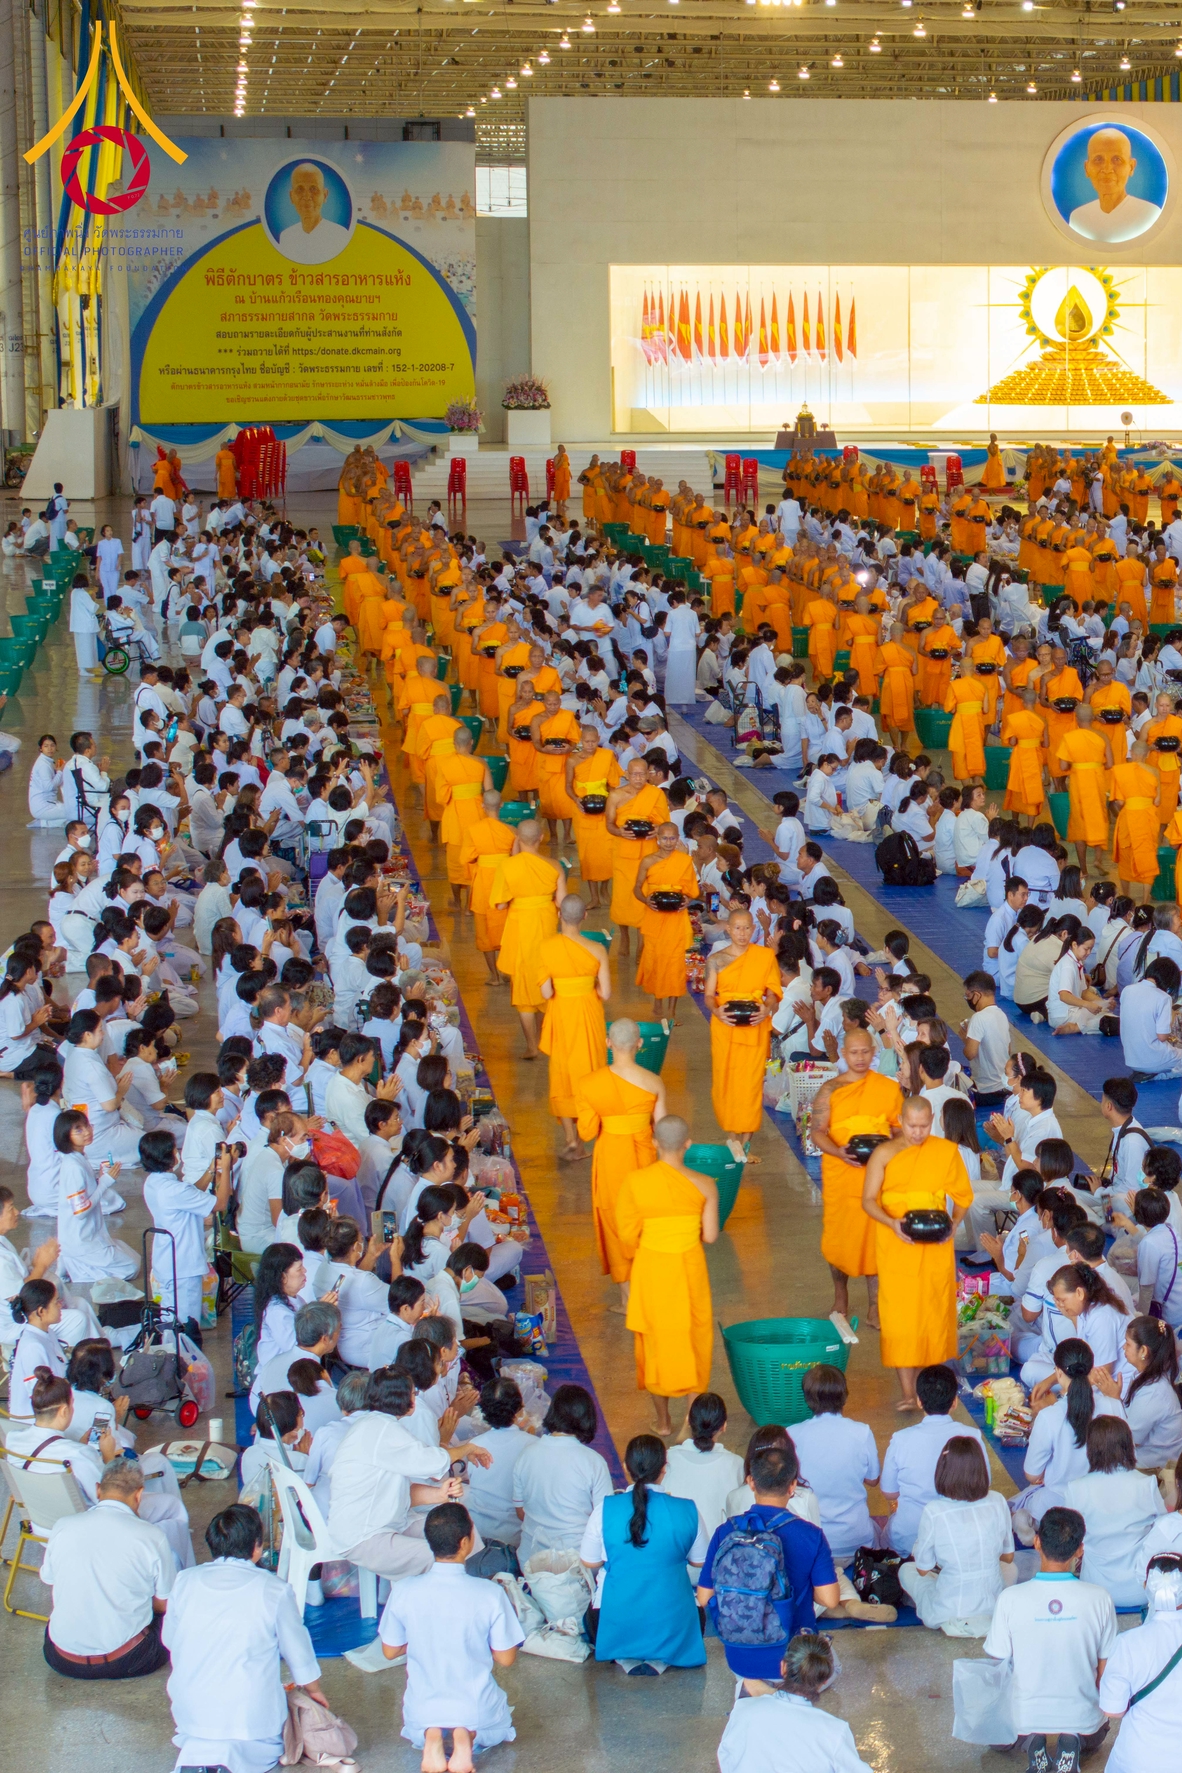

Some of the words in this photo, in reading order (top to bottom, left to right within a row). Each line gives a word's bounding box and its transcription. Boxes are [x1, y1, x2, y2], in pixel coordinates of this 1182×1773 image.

[204, 267, 283, 286] พิธีตักบาตร
[289, 267, 411, 286] ข้าวสารอาหารแห้ง
[234, 295, 246, 305] ณ
[249, 290, 381, 308] บ้านแก้วเรือนทองคุณยายฯ
[220, 311, 315, 322] สภาธรรมกายสากล
[319, 308, 398, 322] วัดพระธรรมกาย
[215, 325, 402, 341] สอบถามรายละเอียดกับผู้ประสานงานที่ท่านสังกัด
[237, 343, 290, 357] ร่วมถวายได้ที่
[158, 363, 257, 378] หรือผ่านธนาคารกรุงไทย
[259, 361, 290, 376] ชื่อบัญชี
[298, 362, 361, 373] วัดพระธรรมกาย
[363, 360, 384, 373] เลขที่
[392, 363, 455, 373] 152-1-20208-7
